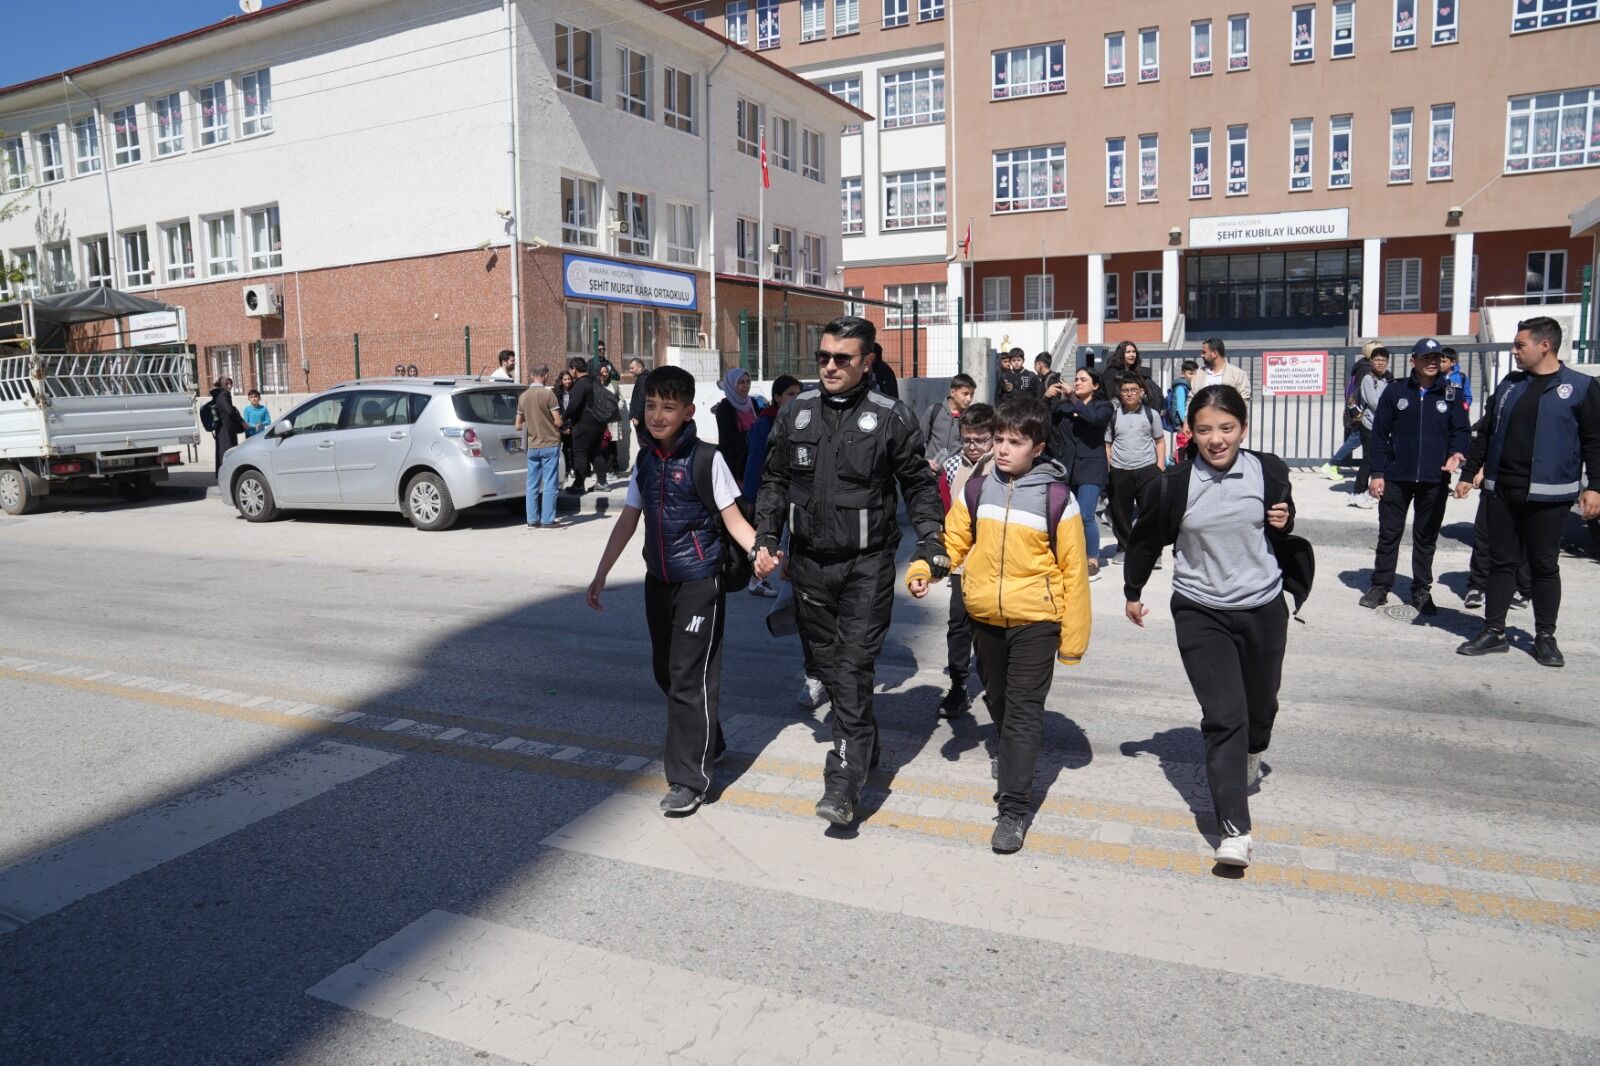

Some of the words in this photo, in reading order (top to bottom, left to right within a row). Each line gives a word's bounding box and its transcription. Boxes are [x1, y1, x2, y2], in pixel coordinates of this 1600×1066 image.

[1217, 229, 1243, 241] ŞEHİT
[1245, 226, 1284, 239] KUBİLAY
[1287, 224, 1335, 236] İLKOKULU
[589, 279, 609, 292] ŞEHİT
[610, 281, 634, 294] MURAT
[635, 284, 653, 297] KARA
[653, 287, 690, 302] ORTAOKULU
